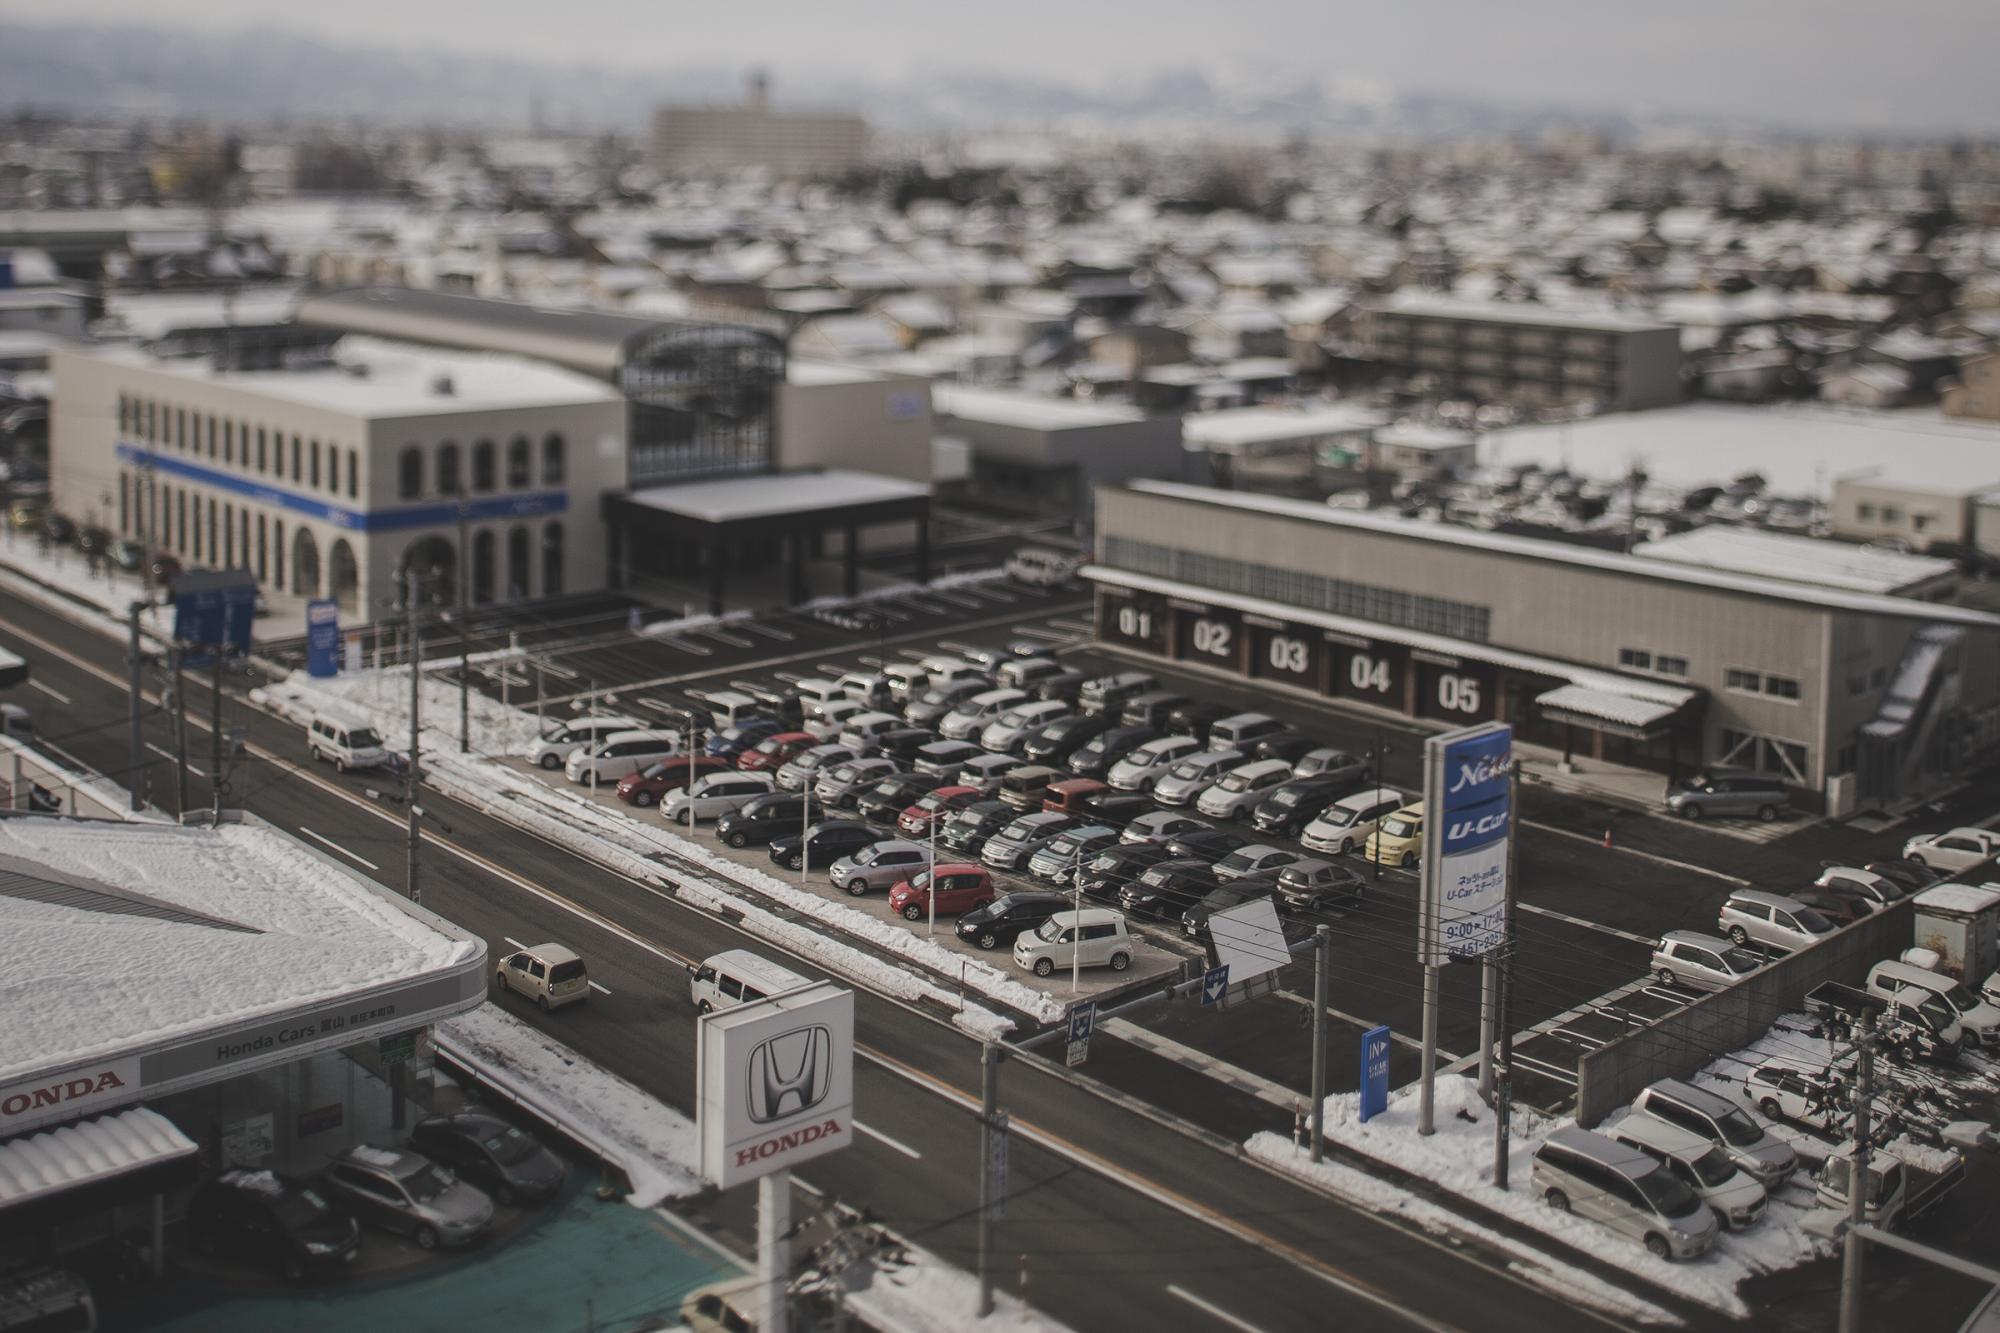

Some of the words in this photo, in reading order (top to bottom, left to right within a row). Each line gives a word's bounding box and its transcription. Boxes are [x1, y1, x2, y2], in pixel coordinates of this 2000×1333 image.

[1119, 606, 1150, 640] 01
[1193, 618, 1231, 657] 02
[1269, 635, 1309, 675] 03
[1351, 653, 1391, 693] 04
[1438, 673, 1480, 714] 05
[1446, 922, 1473, 939] 9:00
[217, 1035, 274, 1060] Honda
[278, 1024, 316, 1044] Cars
[321, 1015, 345, 1033] 富山
[1368, 1039, 1380, 1060] IN
[736, 1119, 842, 1167] HONDA
